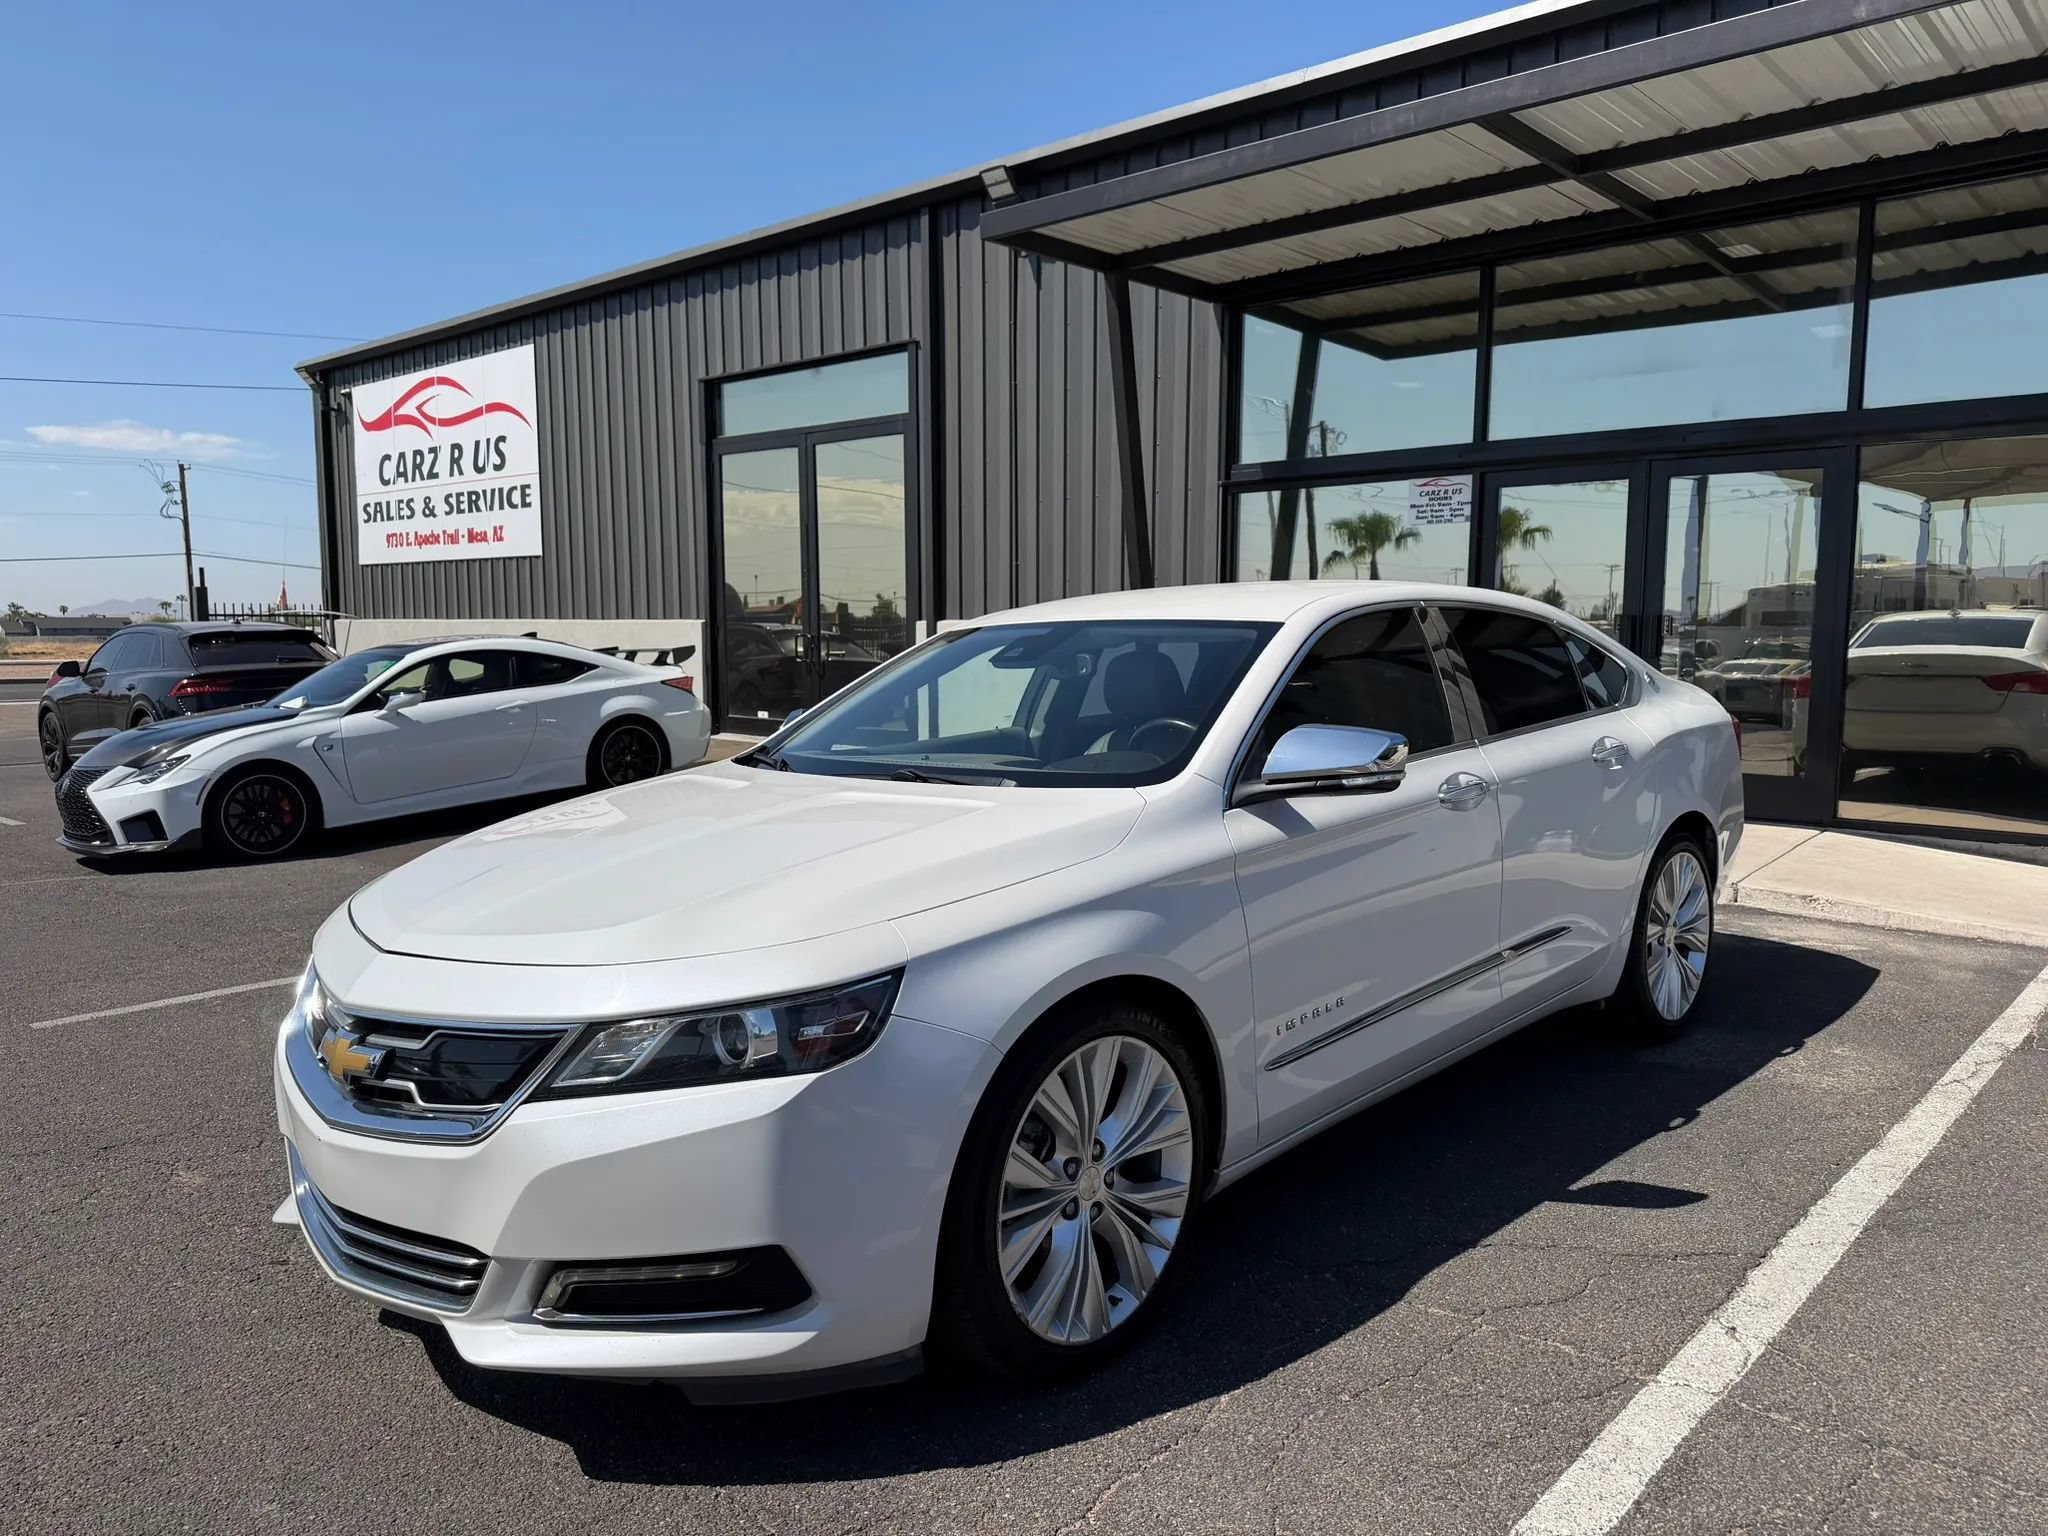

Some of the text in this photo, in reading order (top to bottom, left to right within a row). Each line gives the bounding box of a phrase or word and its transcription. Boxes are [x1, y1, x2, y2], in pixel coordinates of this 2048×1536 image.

[378, 435, 507, 486] CARZ R US
[363, 484, 532, 523] SALES & SERVICE
[1419, 489, 1442, 497] CARZ
[386, 532, 404, 548] 9730
[405, 531, 412, 547] E.
[414, 529, 440, 549] Apache
[442, 528, 459, 545] Trail
[492, 525, 504, 542] AZ
[1276, 996, 1344, 1036] IMPALA
